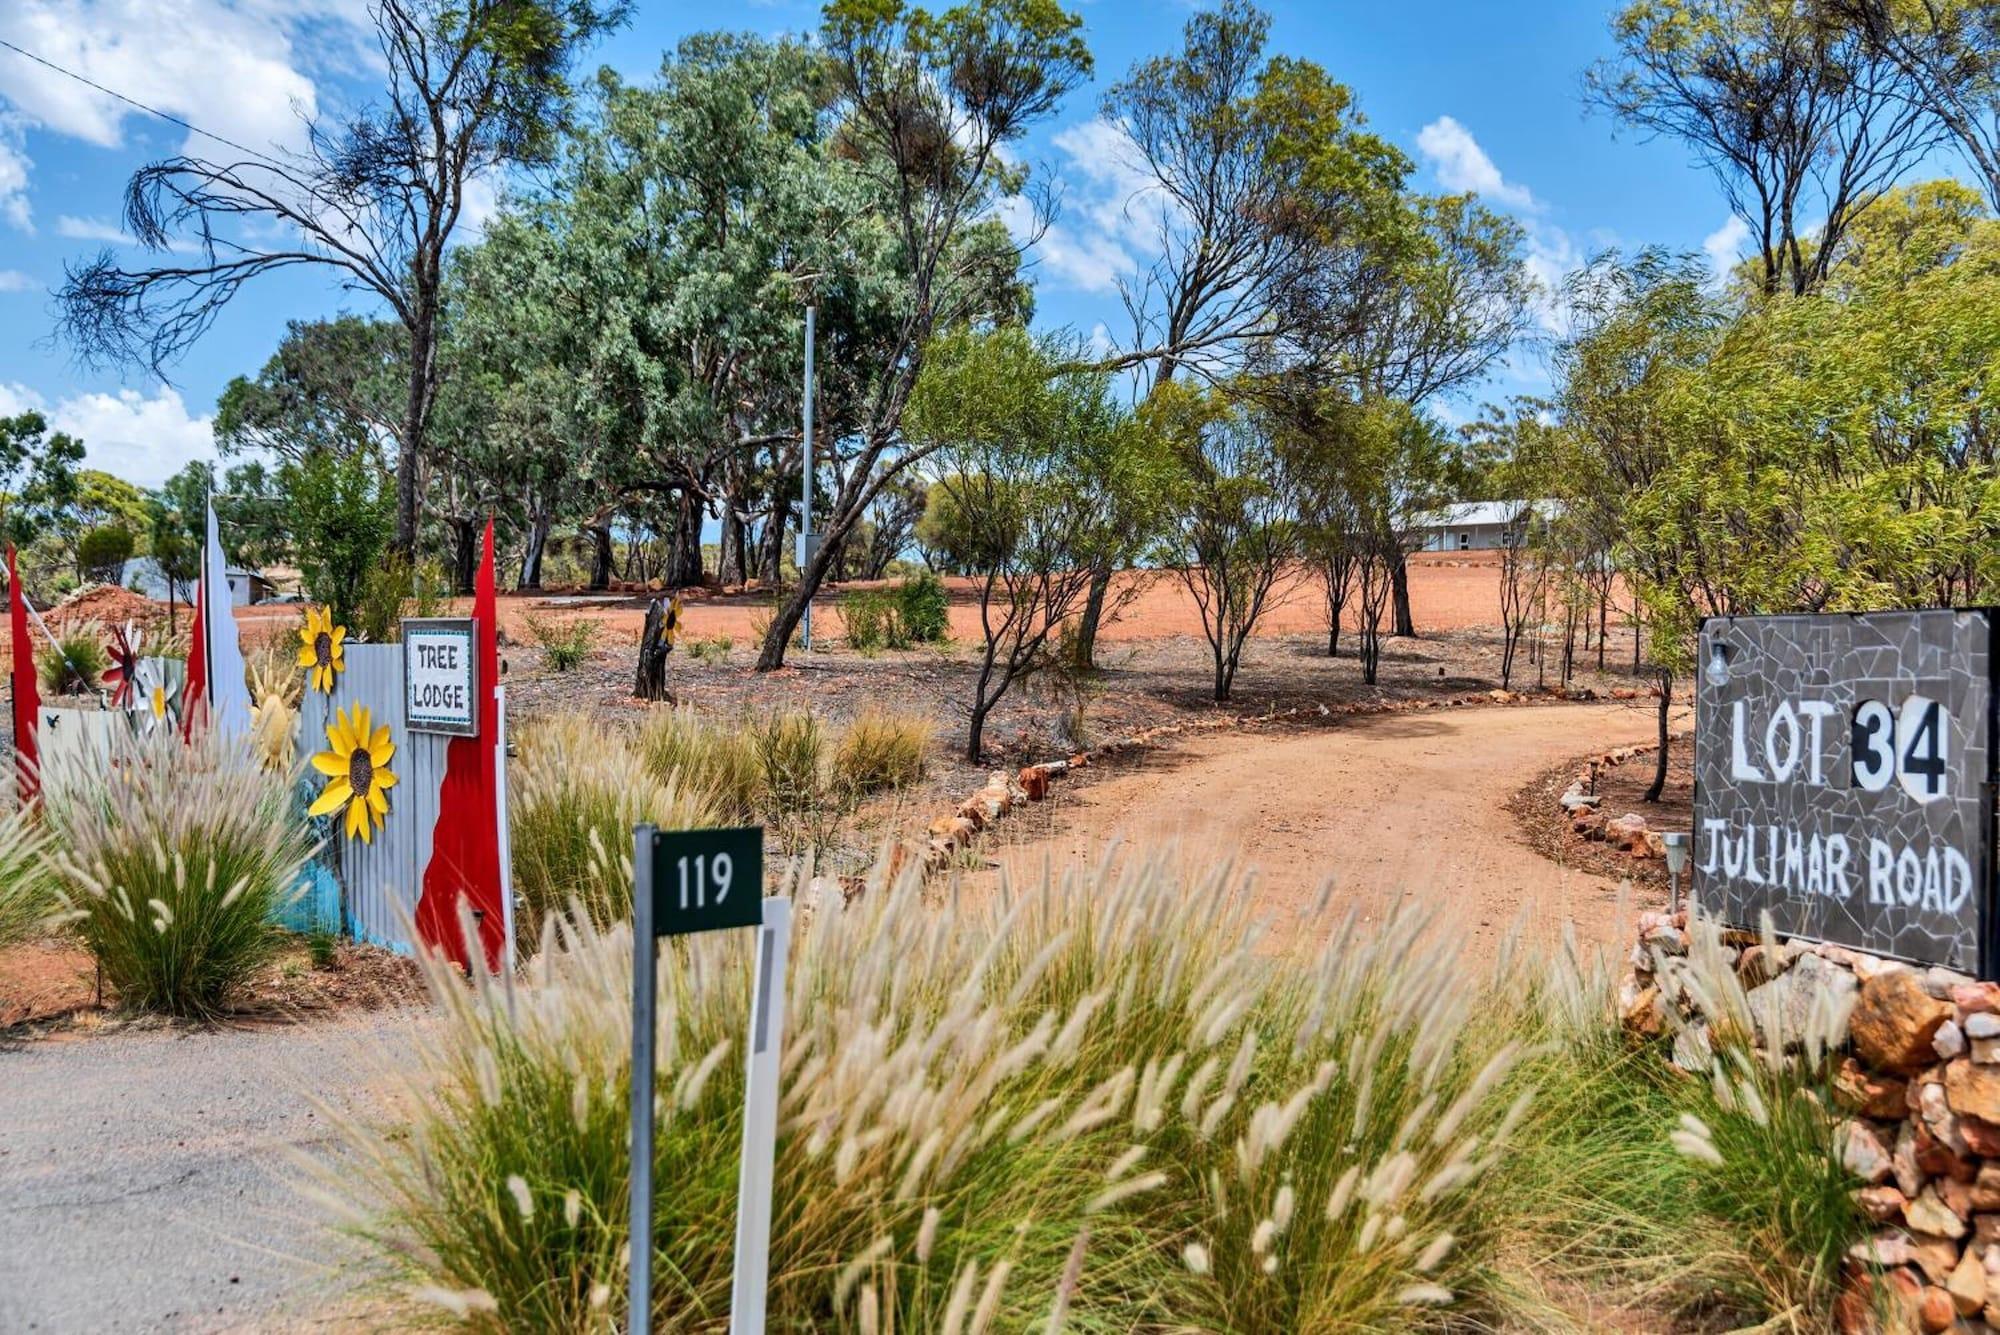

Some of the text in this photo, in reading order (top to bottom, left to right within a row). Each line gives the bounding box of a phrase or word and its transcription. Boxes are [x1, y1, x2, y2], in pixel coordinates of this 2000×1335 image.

[418, 645, 458, 669] TREE
[413, 684, 463, 709] LODGE
[1732, 699, 1946, 793] LOT 34
[677, 852, 733, 909] 119
[1702, 818, 1972, 913] JULIMAR ROAD
